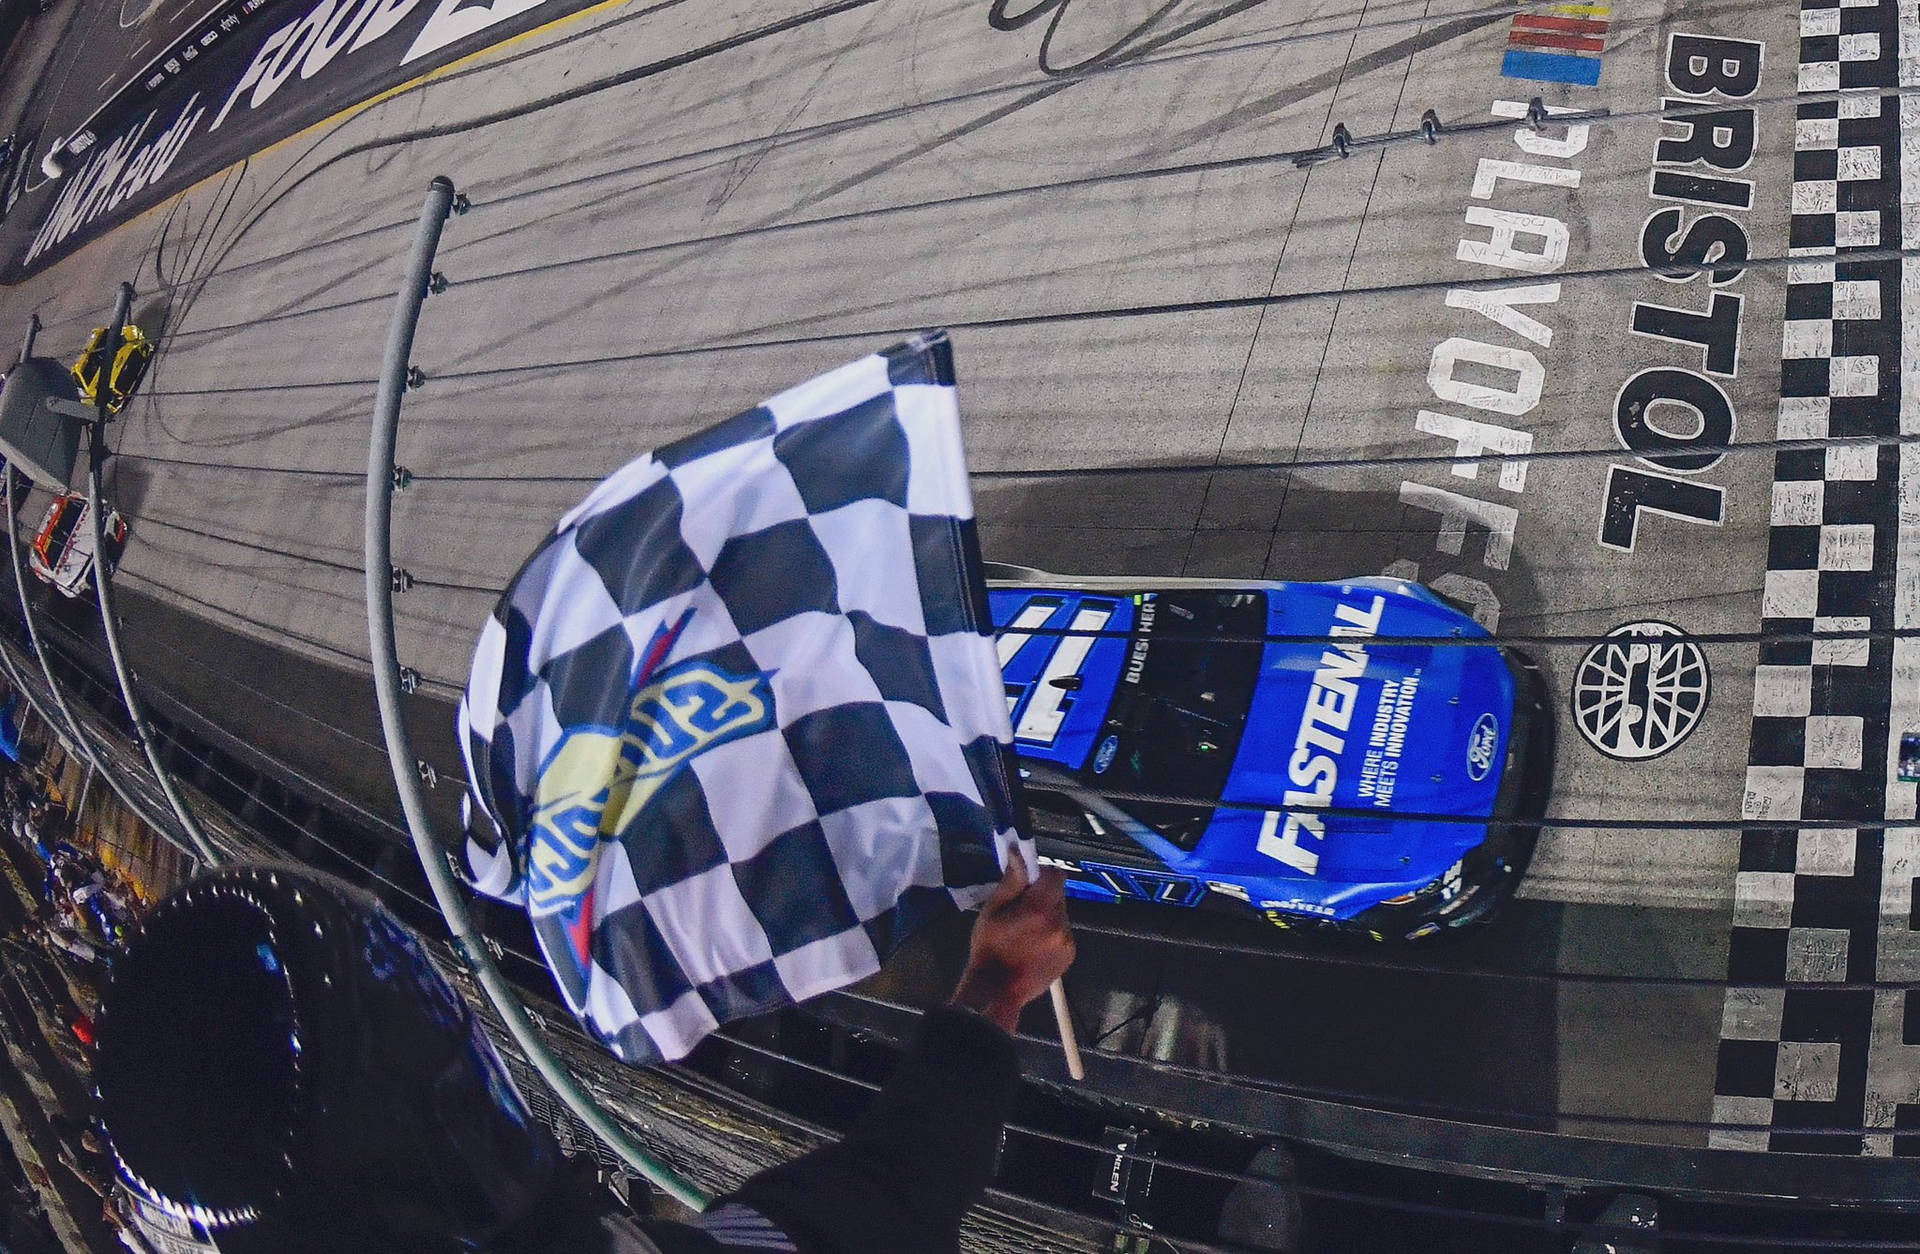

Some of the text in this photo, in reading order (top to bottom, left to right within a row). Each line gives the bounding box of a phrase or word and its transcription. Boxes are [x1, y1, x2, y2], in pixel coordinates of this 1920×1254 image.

[1599, 32, 1766, 553] BRISTOL
[1256, 595, 1386, 876] FASTENAL
[1358, 679, 1399, 798] WHERE INDUSTRY
[1374, 761, 1399, 807] MEETS
[1468, 719, 1497, 773] Ford
